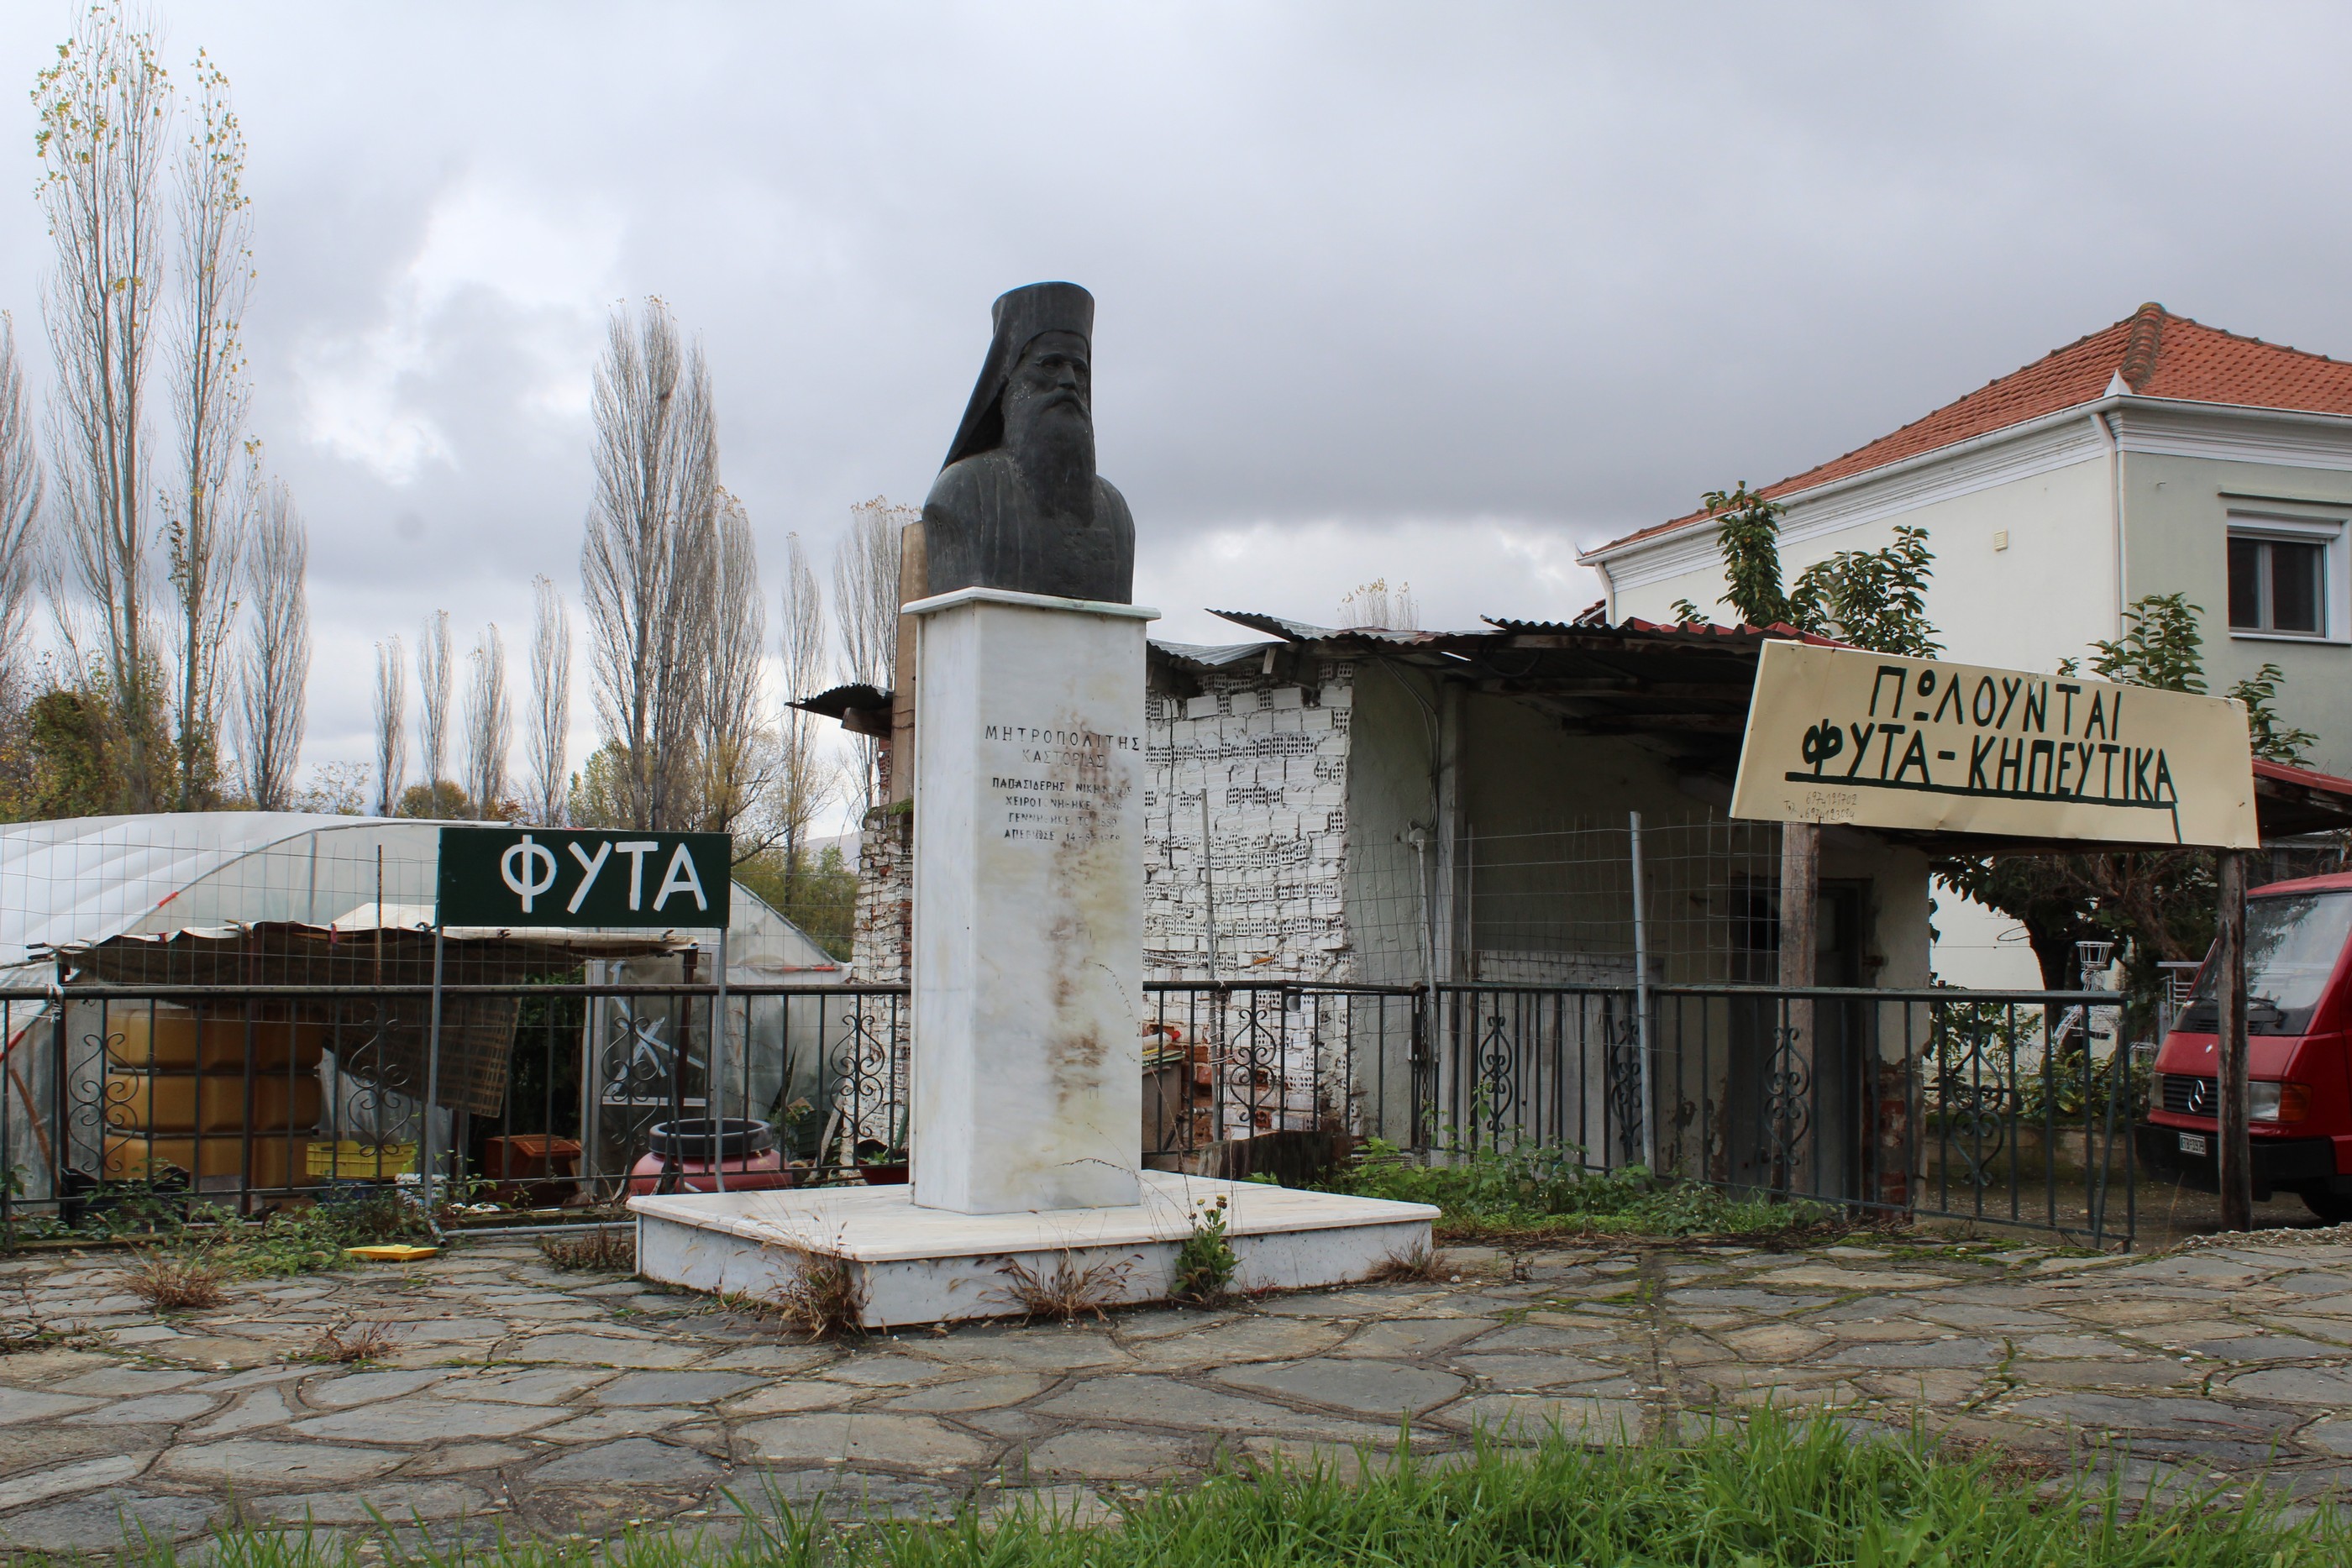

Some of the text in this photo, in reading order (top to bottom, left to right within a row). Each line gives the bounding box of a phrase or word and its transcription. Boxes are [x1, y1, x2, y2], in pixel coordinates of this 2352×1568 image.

[985, 725, 1141, 752] ΜΗΤΡΟΠΟΛΙΤΗΣ
[1021, 749, 1105, 768] ΚΑΣΤΟΡΙΑΣ
[992, 777, 1065, 792] ΠΑΠΑΣΙΔΕΡΗΣ
[500, 834, 708, 915] ΦΥΤΑ
